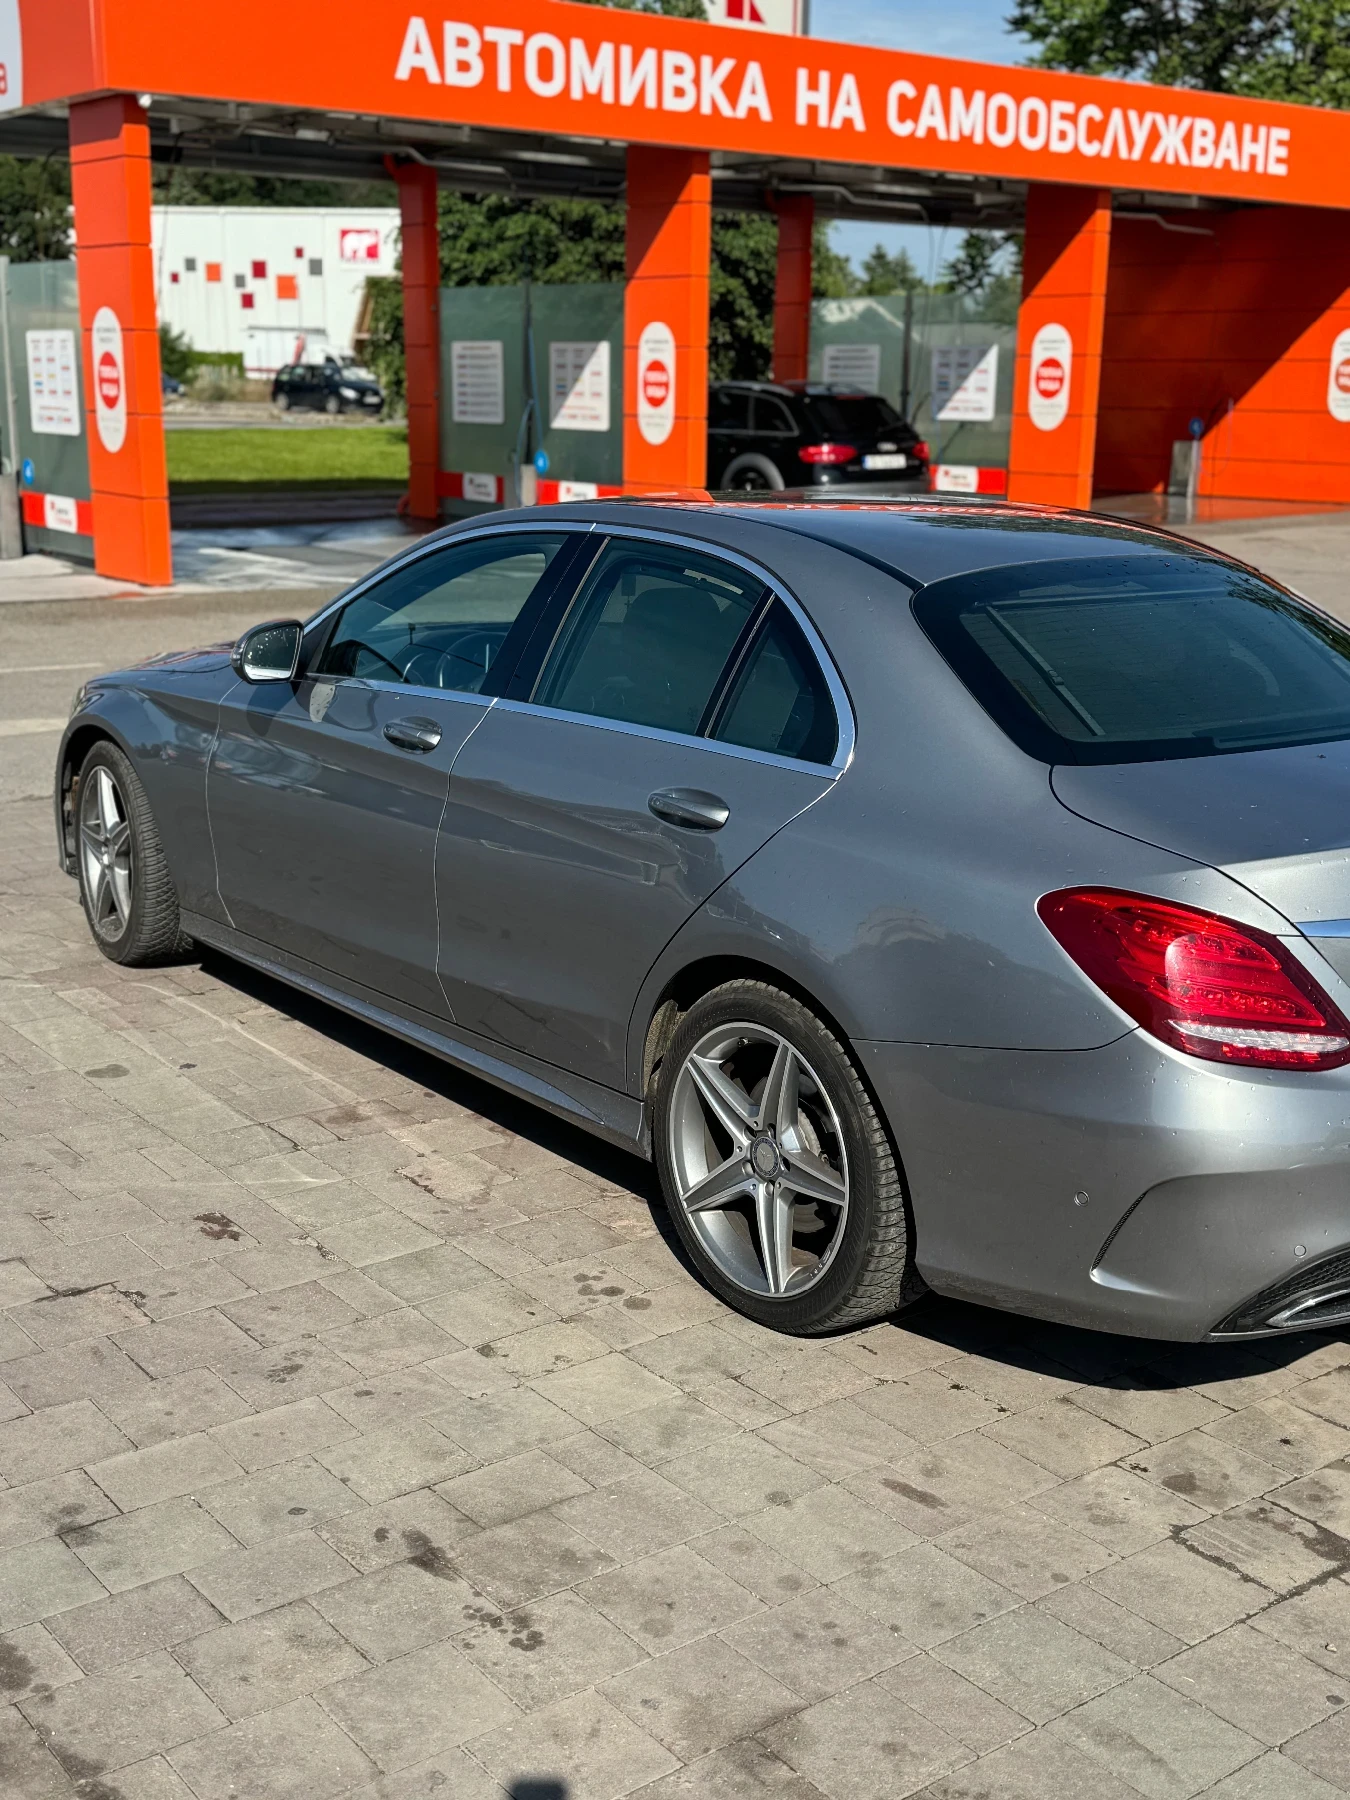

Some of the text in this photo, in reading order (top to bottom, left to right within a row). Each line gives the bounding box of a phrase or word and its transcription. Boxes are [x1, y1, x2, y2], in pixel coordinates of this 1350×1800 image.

[394, 15, 1291, 177] АВТОМИВКА НА САМООБСЛУЖВАНЕ
